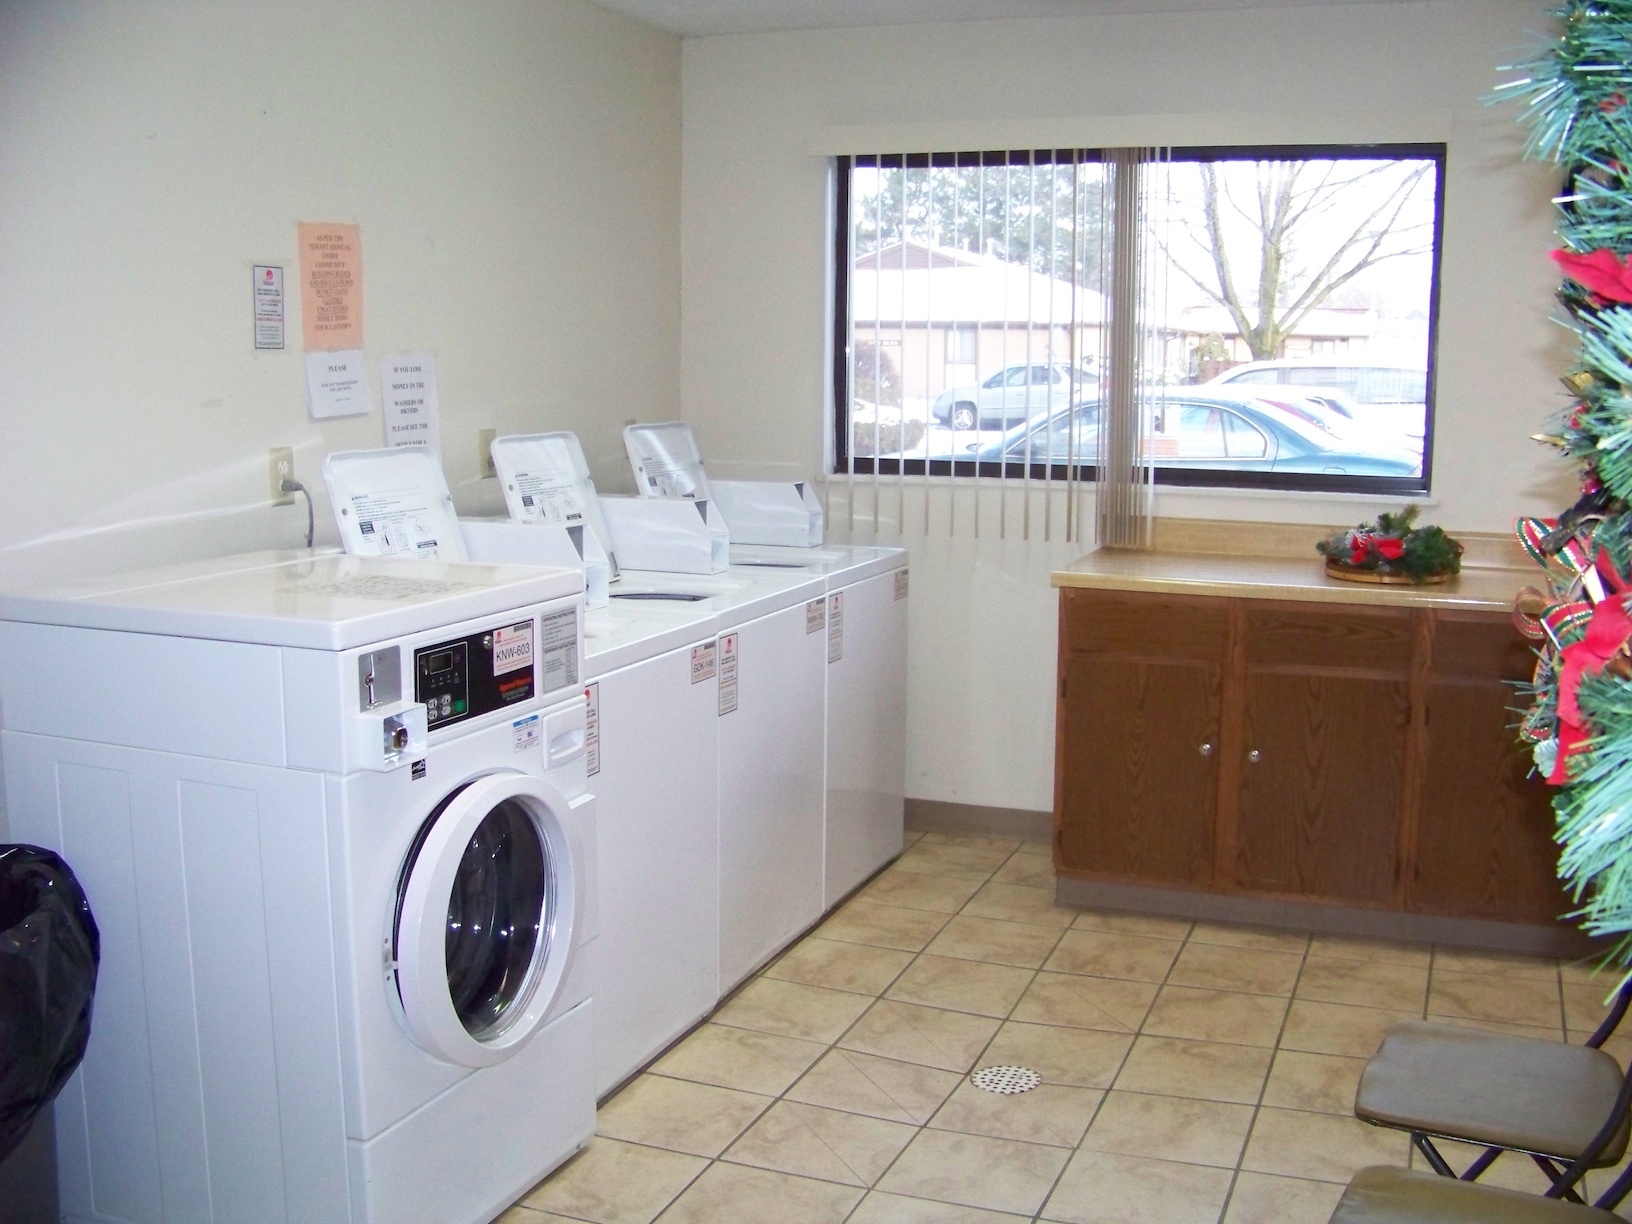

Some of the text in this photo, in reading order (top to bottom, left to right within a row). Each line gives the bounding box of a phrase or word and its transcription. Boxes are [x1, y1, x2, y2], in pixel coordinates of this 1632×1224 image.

[309, 243, 352, 251] TENANT MANUAL
[321, 252, 338, 260] UNDER
[329, 322, 352, 330] LAUNDRY
[328, 364, 347, 373] PLEASE
[400, 407, 419, 415] DRYERS
[392, 422, 428, 432] PLEASE SEE THE
[496, 642, 530, 663] KNW-603
